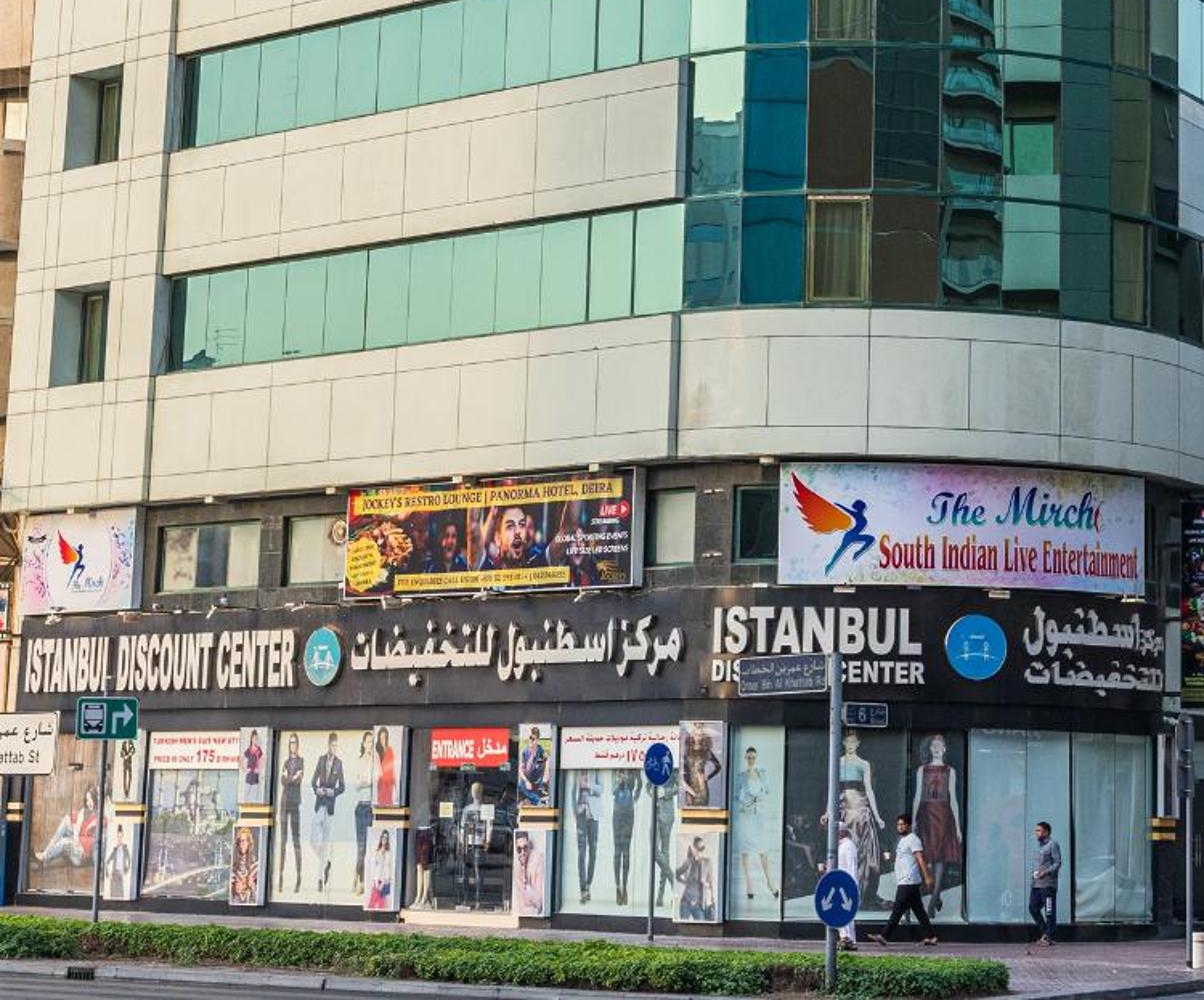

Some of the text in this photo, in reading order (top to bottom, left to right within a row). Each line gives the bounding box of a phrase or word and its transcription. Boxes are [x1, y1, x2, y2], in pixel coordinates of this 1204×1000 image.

[443, 491, 482, 505] LOUNGE
[581, 481, 613, 495] DEIRA
[600, 505, 618, 516] LIVE
[926, 491, 986, 527] The
[879, 534, 1139, 580] South Indian Live Entertainment
[713, 606, 922, 656] ISTANBUL
[1023, 606, 1140, 660] اسطنبول
[25, 628, 296, 693] ISTANBUL DISCOUNT CENTER
[351, 614, 685, 687] مركز اسطنبول للتخفيضات
[1024, 660, 1163, 697] للتخفيضات
[24, 721, 54, 744] شارع
[28, 749, 40, 763] St
[196, 749, 215, 763] 175
[432, 740, 475, 760] ENTRANCE
[477, 738, 507, 759] مدخل
